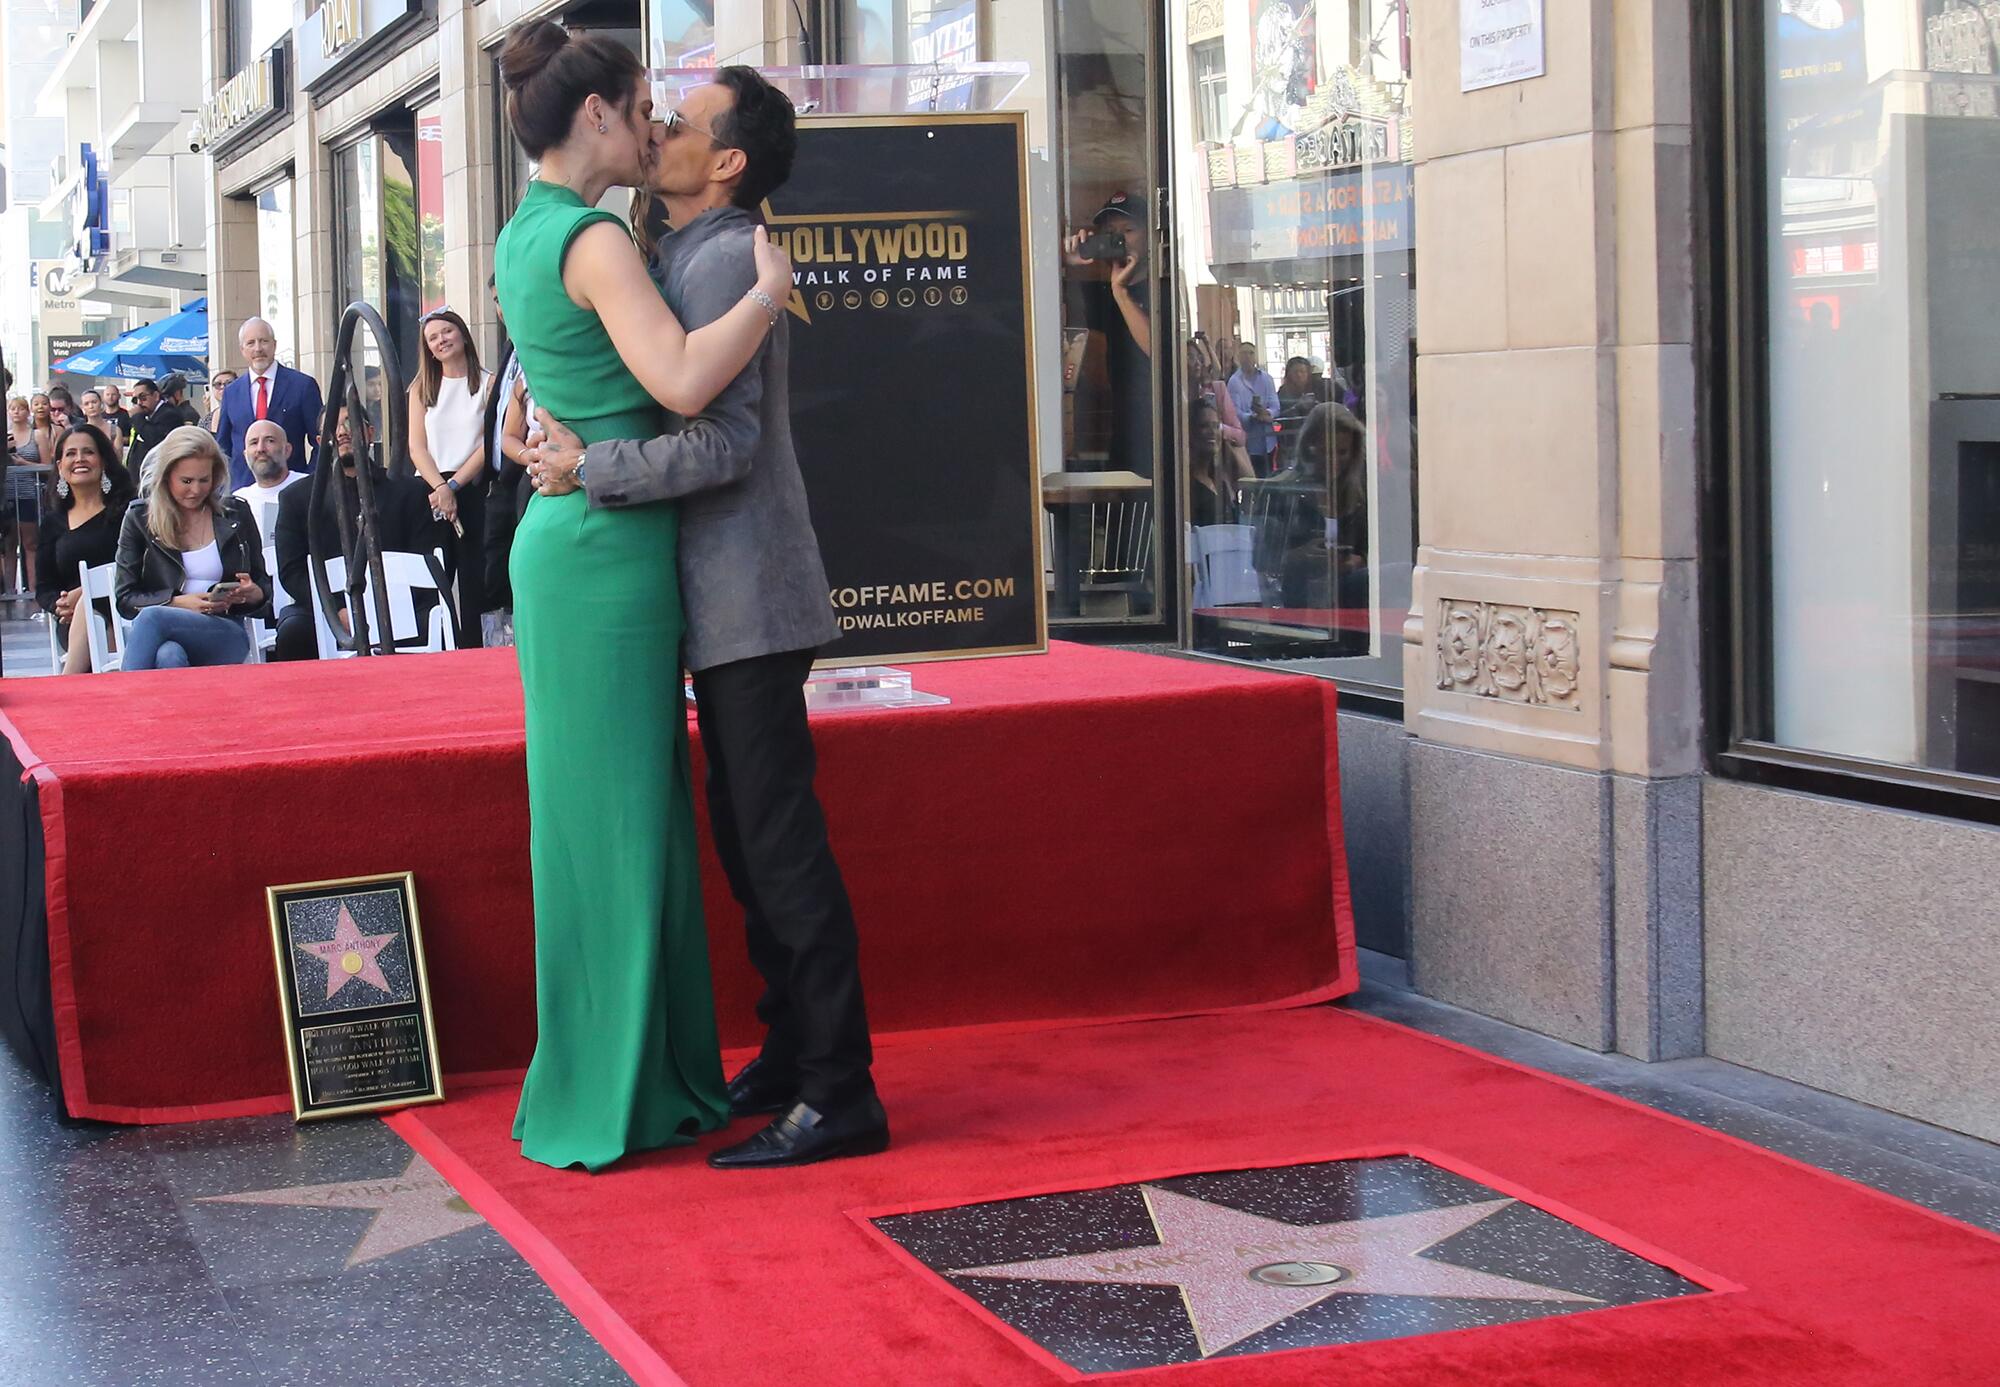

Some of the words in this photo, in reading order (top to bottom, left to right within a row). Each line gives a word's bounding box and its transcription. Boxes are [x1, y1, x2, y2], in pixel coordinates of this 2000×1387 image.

[769, 222, 968, 264] HOLLYWOOD
[791, 270, 850, 286] WALK
[863, 269, 892, 283] OF
[906, 265, 968, 281] FAME
[44, 300, 76, 309] Metro
[829, 577, 1015, 609] KOFFAME.COM
[836, 607, 984, 631] DWALKOFFAME
[319, 943, 342, 954] MARC
[345, 939, 381, 951] ANTHONY
